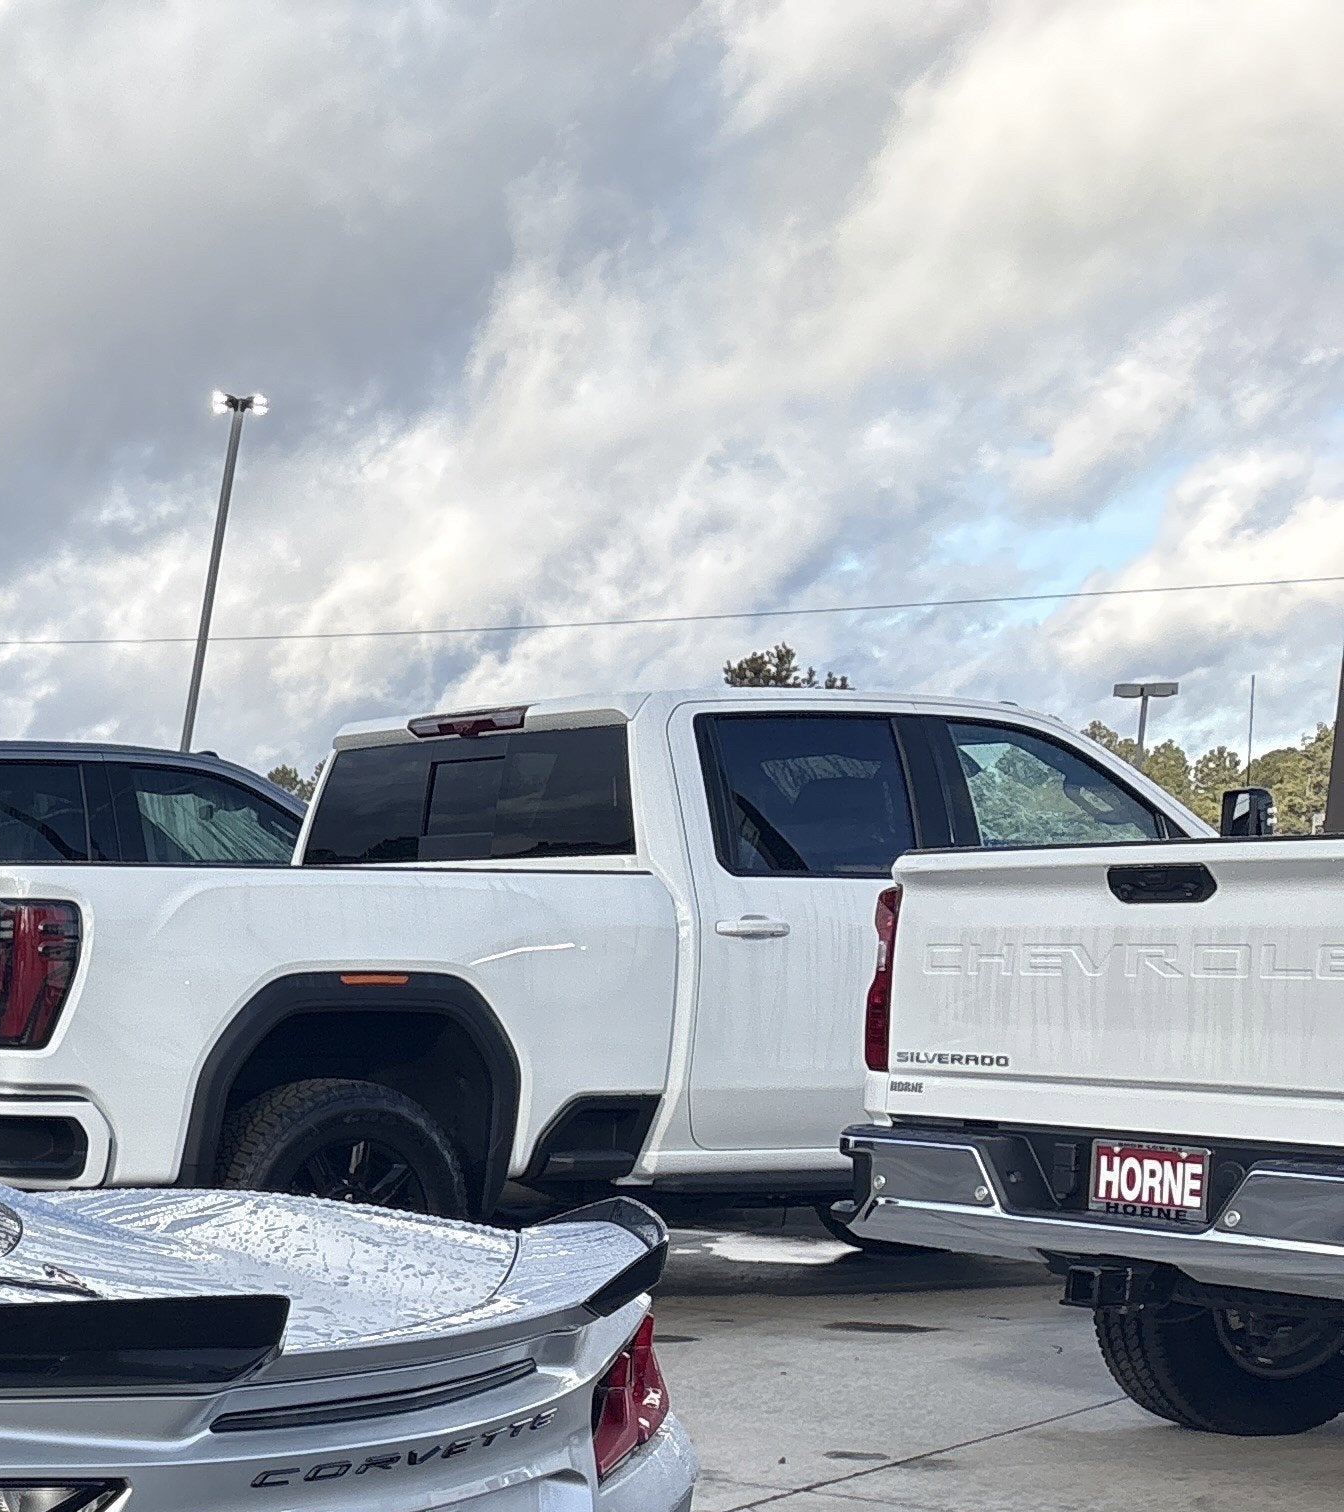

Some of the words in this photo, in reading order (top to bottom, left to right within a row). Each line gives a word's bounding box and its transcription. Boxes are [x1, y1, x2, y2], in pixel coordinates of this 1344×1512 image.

[895, 1051, 1010, 1067] SILVERADO
[889, 1080, 924, 1093] HORNE
[1098, 1154, 1203, 1208] HORNE
[1105, 1201, 1188, 1221] HORNE
[249, 1406, 558, 1488] CORVETTE
